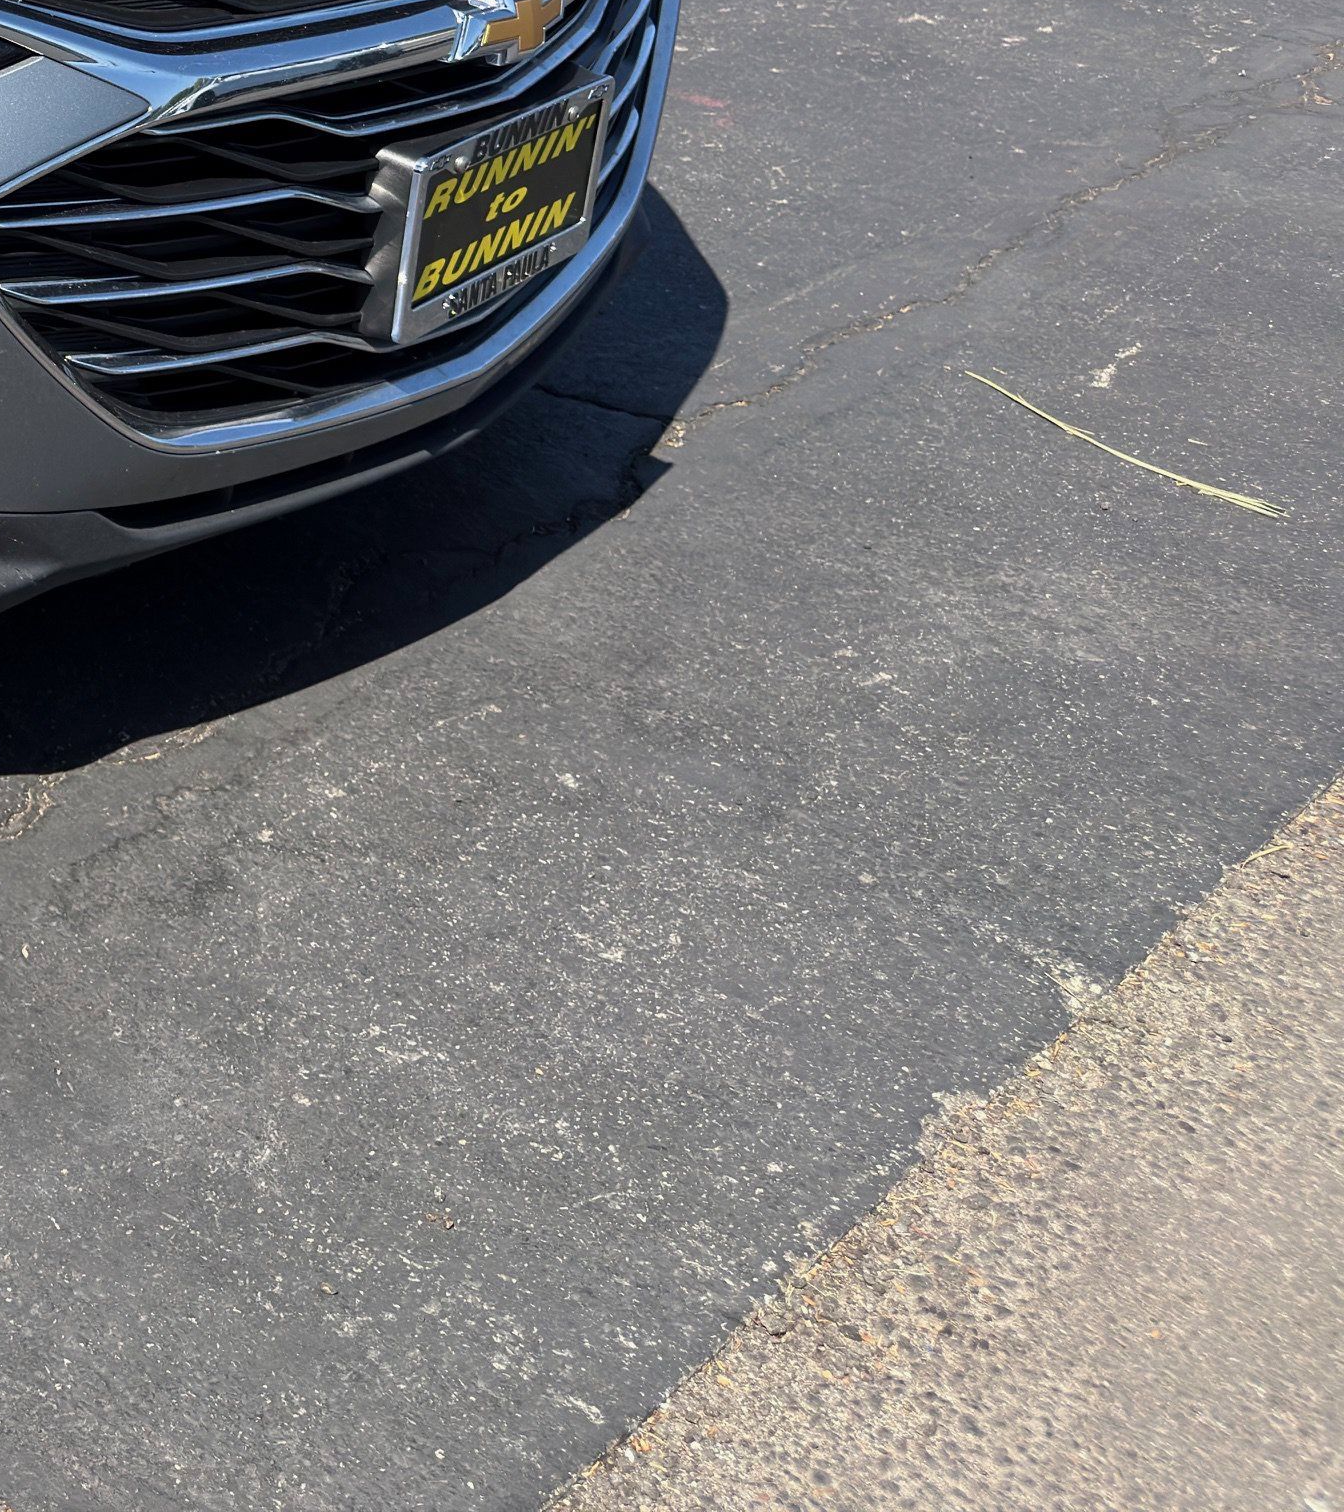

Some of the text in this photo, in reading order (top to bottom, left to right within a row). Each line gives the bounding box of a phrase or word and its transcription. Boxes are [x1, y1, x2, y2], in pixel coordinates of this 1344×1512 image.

[474, 99, 569, 160] BUNNIN
[423, 113, 597, 220] RUNNIN'
[485, 186, 528, 222] to
[412, 191, 576, 302] BUNNIN
[502, 245, 555, 290] PAULA
